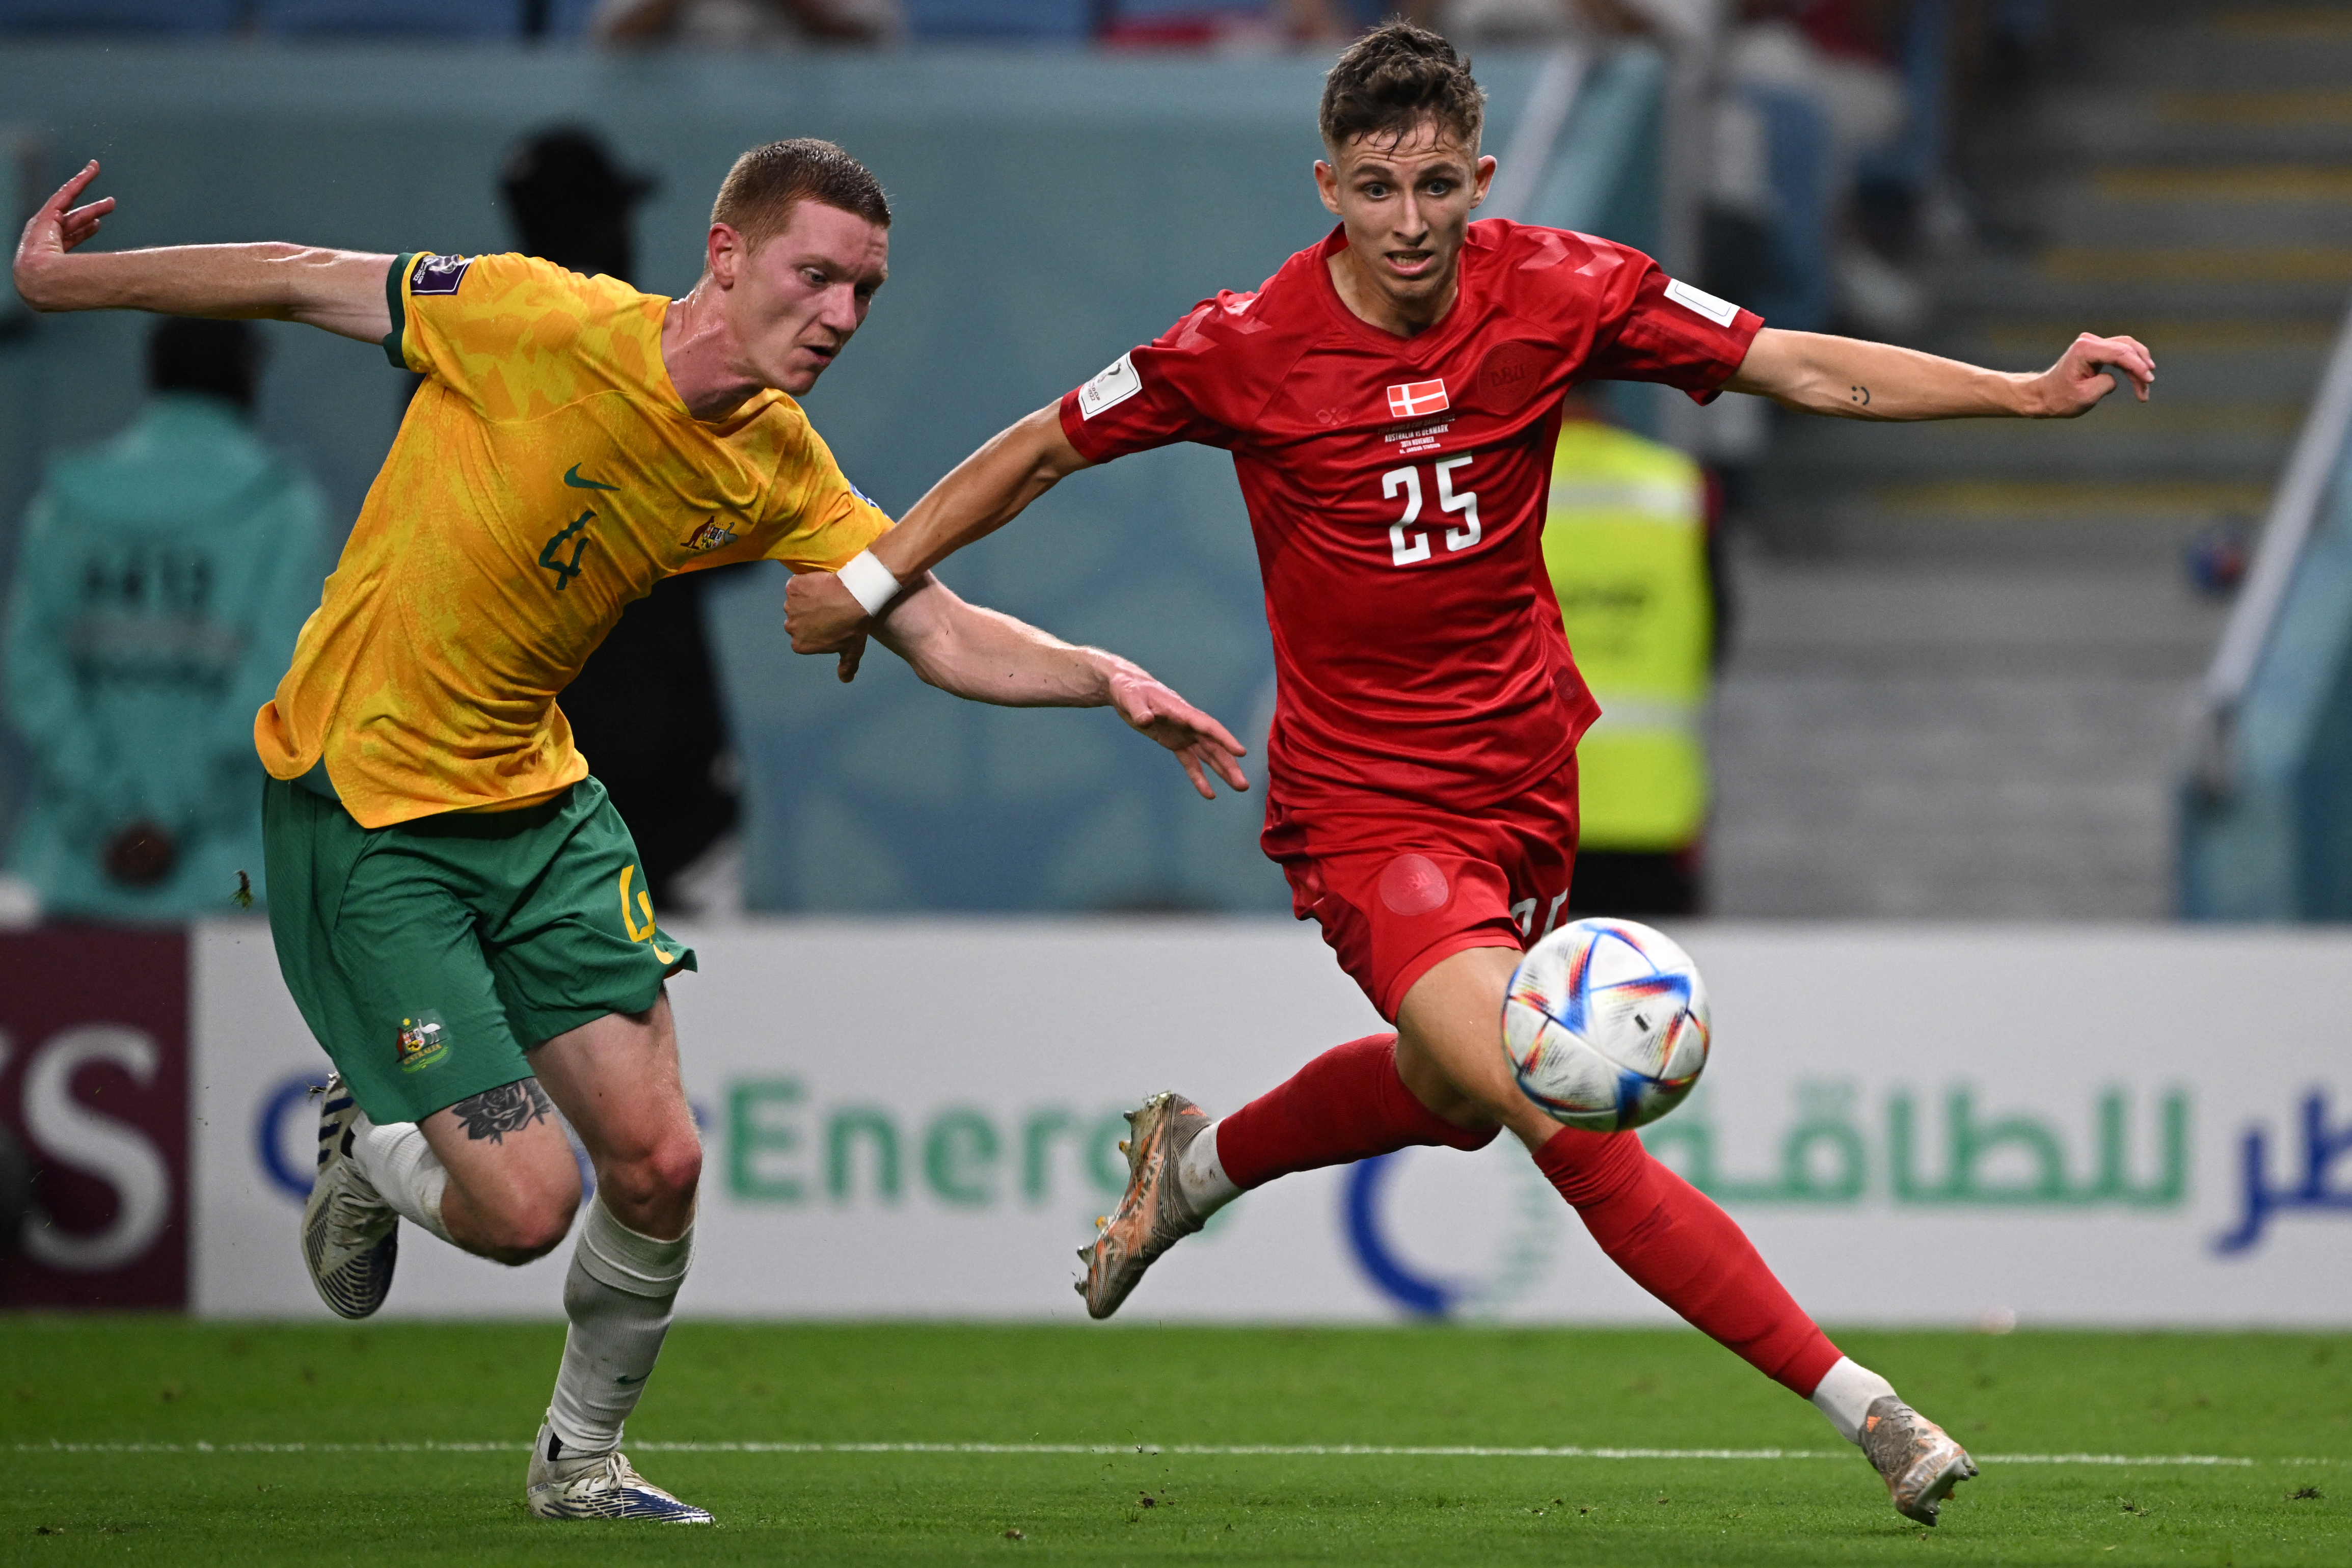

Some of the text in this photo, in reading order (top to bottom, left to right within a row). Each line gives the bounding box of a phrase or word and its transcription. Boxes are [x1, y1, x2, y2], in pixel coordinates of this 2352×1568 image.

[1490, 364, 1526, 388] DBU
[1385, 430, 1415, 443] AUSTRALIA
[1422, 424, 1449, 436] DENMARK
[1412, 436, 1435, 446] NOVEMBER
[1382, 450, 1481, 566] 25
[538, 510, 597, 590] 4
[619, 864, 656, 945] 4
[0, 1023, 169, 1272] S
